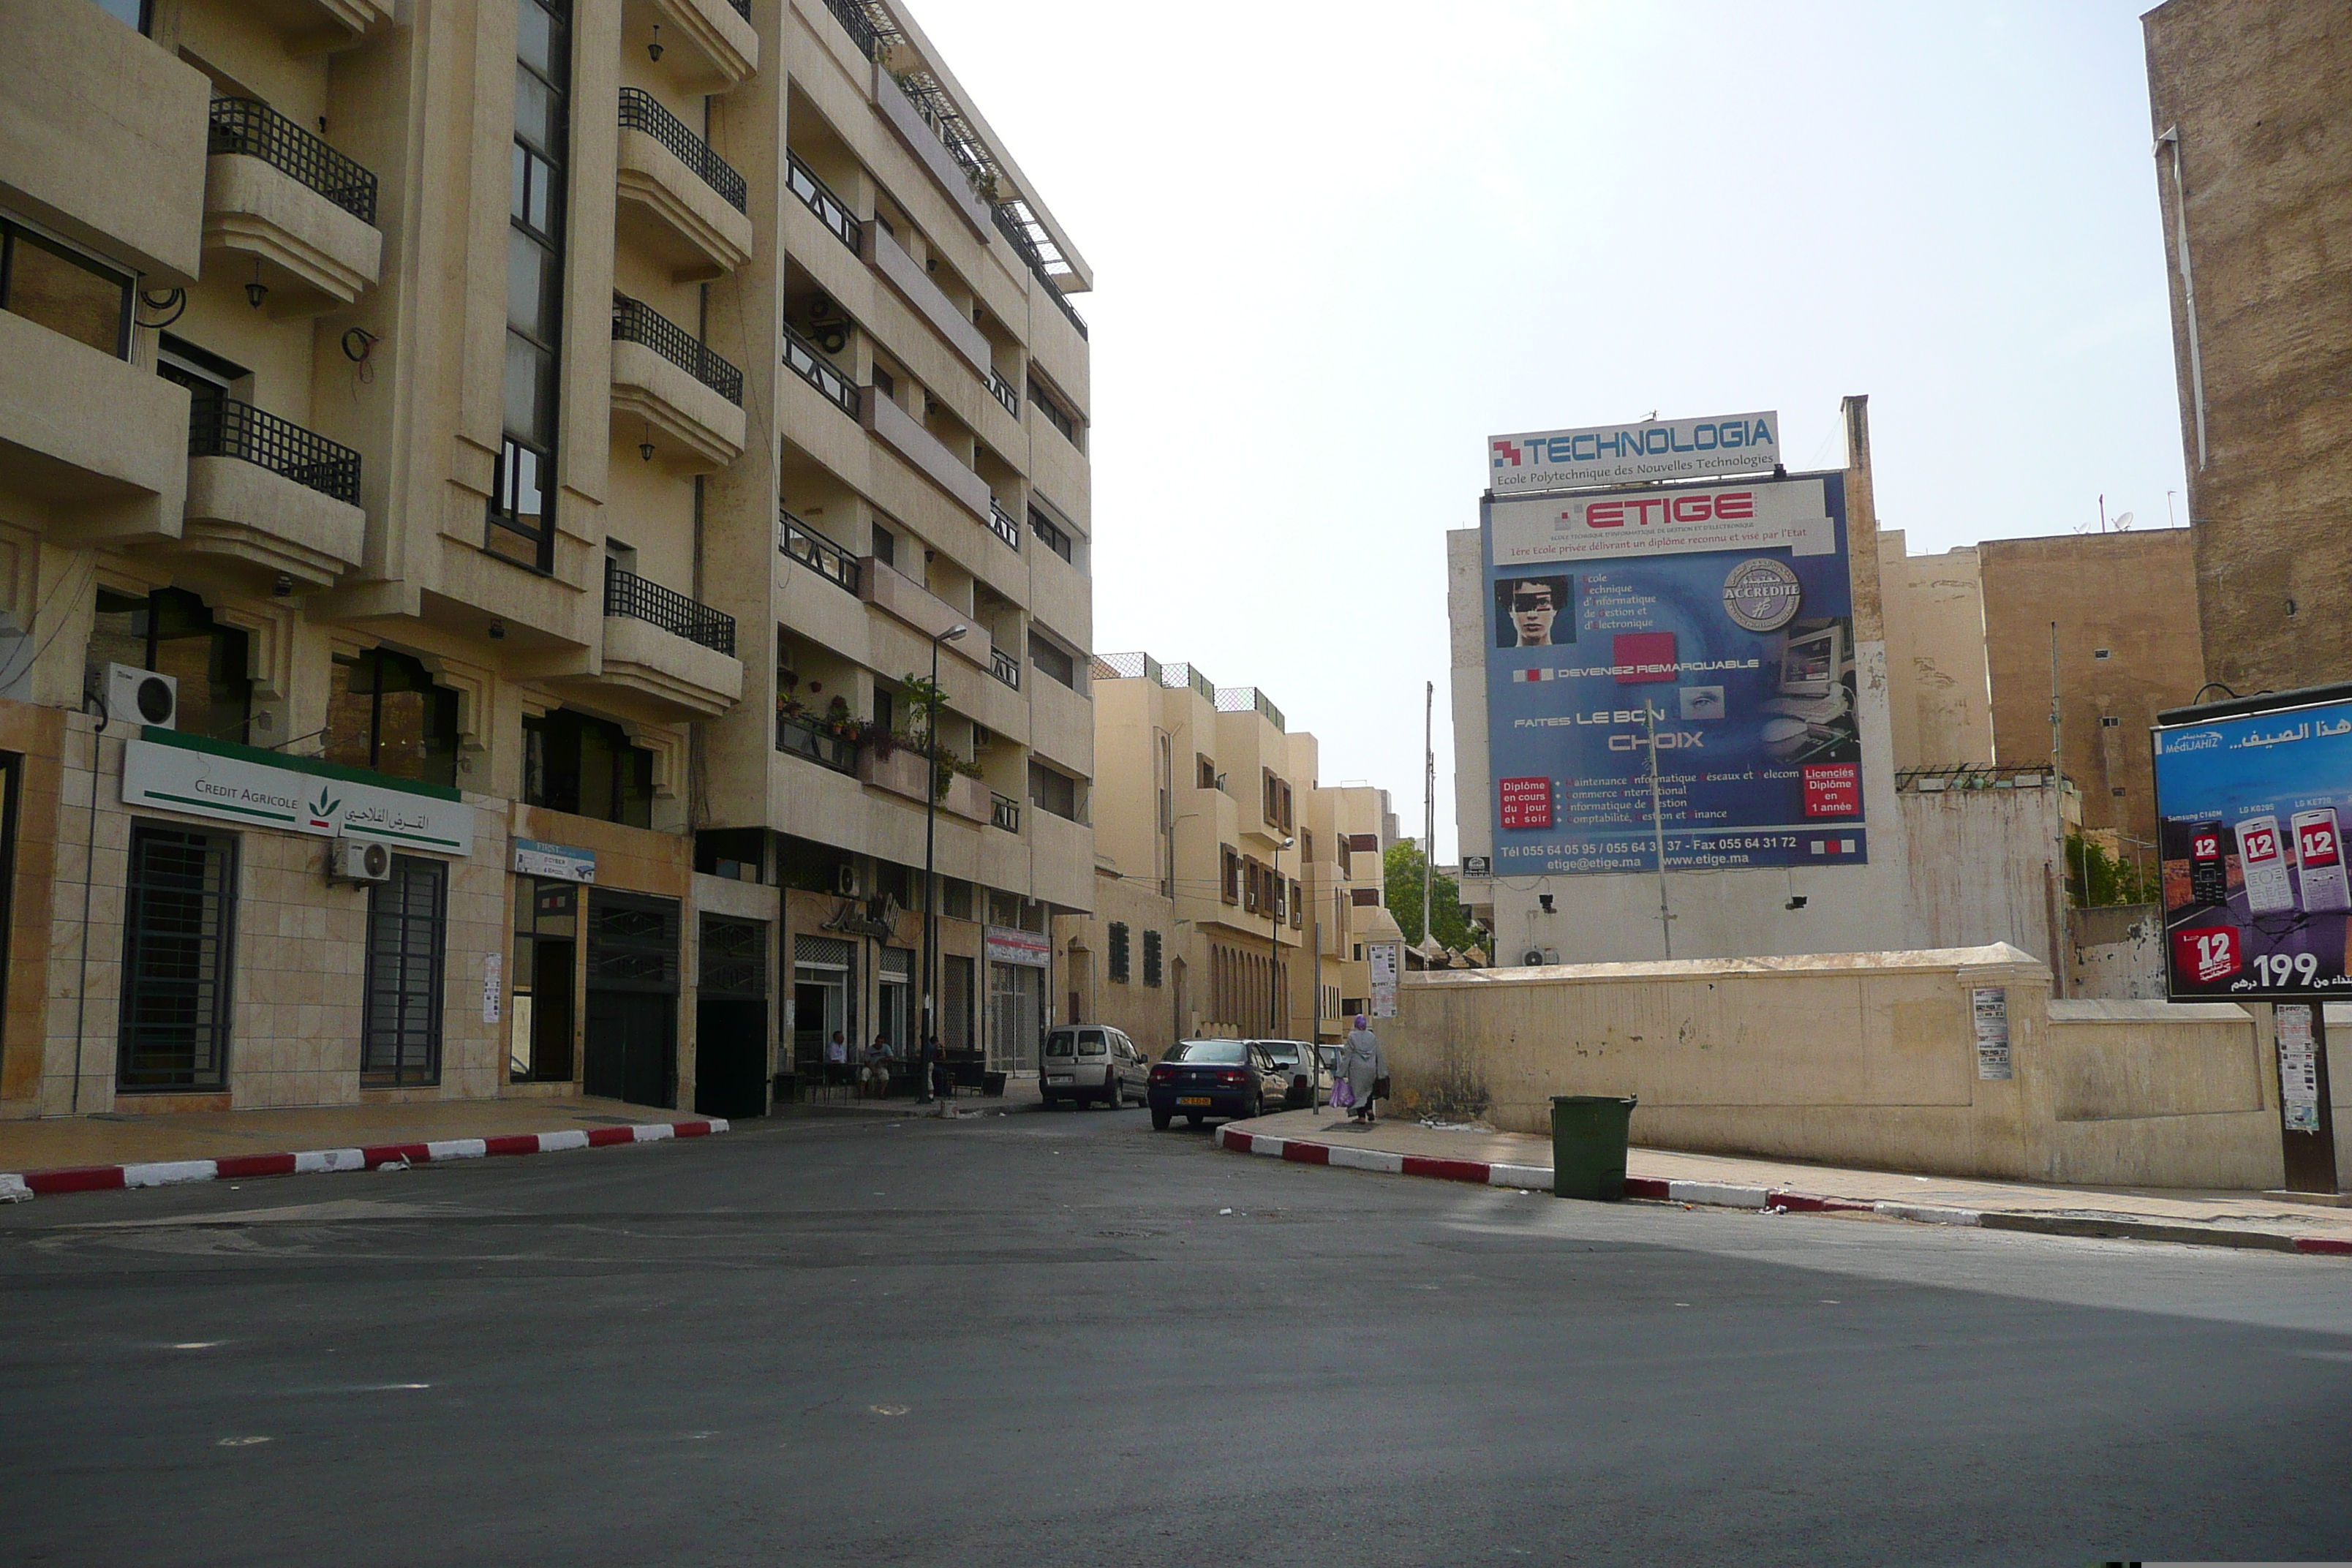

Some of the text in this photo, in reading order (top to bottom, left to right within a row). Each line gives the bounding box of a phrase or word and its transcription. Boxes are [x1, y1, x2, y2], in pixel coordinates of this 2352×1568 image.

[1524, 419, 1773, 464] TECHNOLOGIA
[1498, 454, 1774, 486] Ecole Polytechnique des Nouvelles Technologies
[1586, 492, 1754, 529] ETIGE
[1533, 545, 1556, 554] Ecole
[1559, 543, 1586, 554] privée
[1589, 539, 1630, 551] délivrant
[1633, 540, 1645, 548] un
[1648, 536, 1685, 548] diplôme
[1688, 534, 1727, 544] reconnu
[1730, 532, 1738, 541] et
[1741, 532, 1759, 540] visé
[1763, 532, 1779, 542] par
[1782, 528, 1807, 538] l'Etat
[1571, 532, 1603, 540] TECHNIQUE
[1605, 529, 1656, 538] D'INFORMATIQUE
[1725, 585, 1800, 599] ACCREDITE
[1584, 607, 1647, 618] de Gestion et
[1558, 659, 1760, 678] DEVENEZ REMARQUABLE
[1515, 717, 1570, 728] FAITES
[1576, 711, 1609, 725] LE
[2316, 719, 2352, 737] هذا
[1609, 731, 1705, 751] CHOIX
[1743, 770, 1754, 780] et
[1805, 768, 1855, 779] Licenciés
[1504, 782, 1545, 792] Diplôme
[1809, 780, 1851, 791] Diplôme
[1825, 793, 1837, 801] en
[1525, 804, 1546, 814] jour
[1635, 799, 1646, 809] de
[1812, 802, 1852, 811] 1 année
[1524, 815, 1547, 823] soir
[1676, 810, 1686, 820] et
[2168, 813, 2198, 823] Samsung
[537, 842, 561, 853] FIRST
[1501, 846, 1519, 857] Tél
[1523, 845, 1543, 856] 055
[1547, 845, 1561, 855] 64
[1564, 844, 1578, 854] 05
[1582, 843, 1596, 854] 95
[1606, 842, 1628, 853] 055
[1631, 842, 1646, 852] 64
[1667, 840, 1681, 851] 37
[1693, 840, 1716, 850] Fax
[1719, 839, 1741, 849] 055
[1745, 838, 1760, 848] 64
[1763, 837, 1776, 848] 31
[1781, 837, 1796, 848] 72
[2195, 839, 2216, 856] 12
[2247, 834, 2274, 859] 12
[2302, 831, 2334, 857] 12
[1547, 853, 1749, 871] etige@etige.ma www.etige.ma
[2197, 932, 2231, 970] 12
[2253, 953, 2318, 987] 199
[2231, 979, 2258, 992] درهم
[2313, 977, 2329, 988] من
